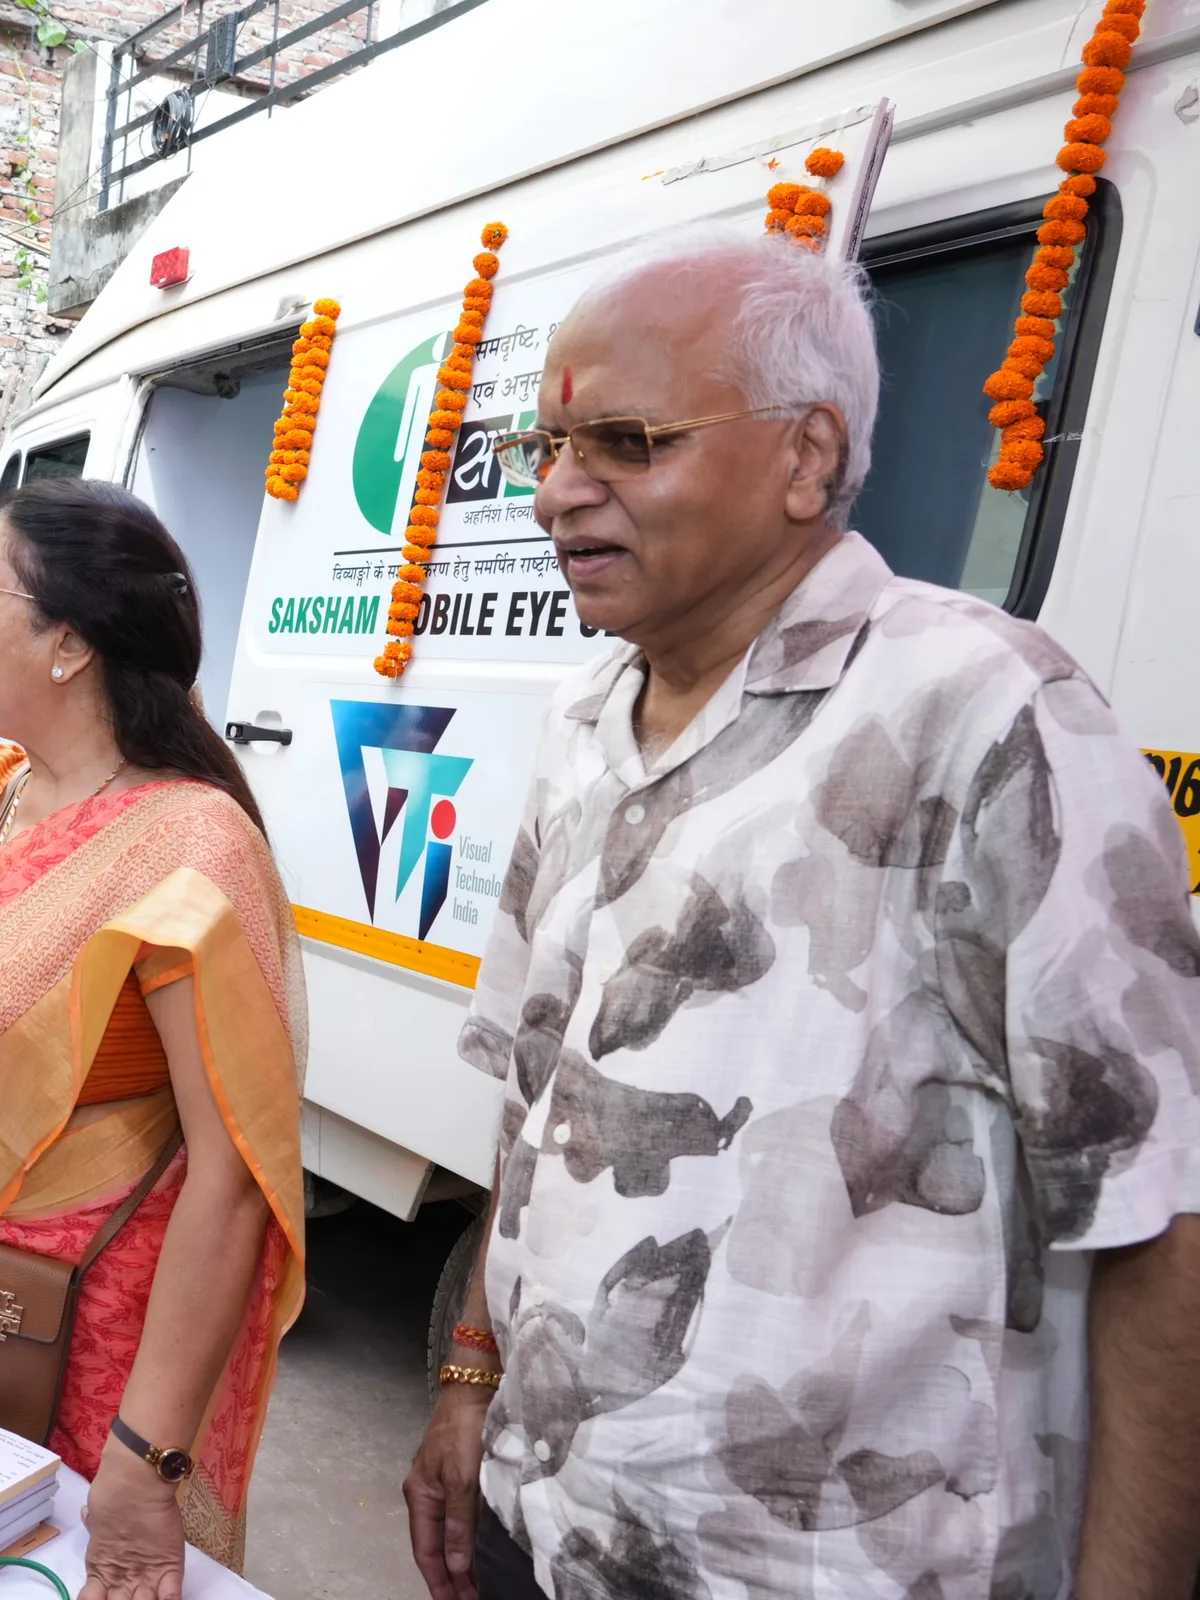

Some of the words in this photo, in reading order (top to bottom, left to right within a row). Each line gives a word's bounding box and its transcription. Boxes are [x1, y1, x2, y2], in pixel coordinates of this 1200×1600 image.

[472, 373, 500, 408] एवं
[373, 562, 386, 580] के
[453, 555, 471, 582] हेतु
[474, 553, 516, 576] समर्पित
[268, 595, 380, 635] SAKSHAM
[386, 591, 498, 636] OBILE
[505, 590, 571, 636] EYE
[459, 835, 492, 864] Visual
[456, 866, 501, 898] Technolo
[452, 897, 479, 925] India
